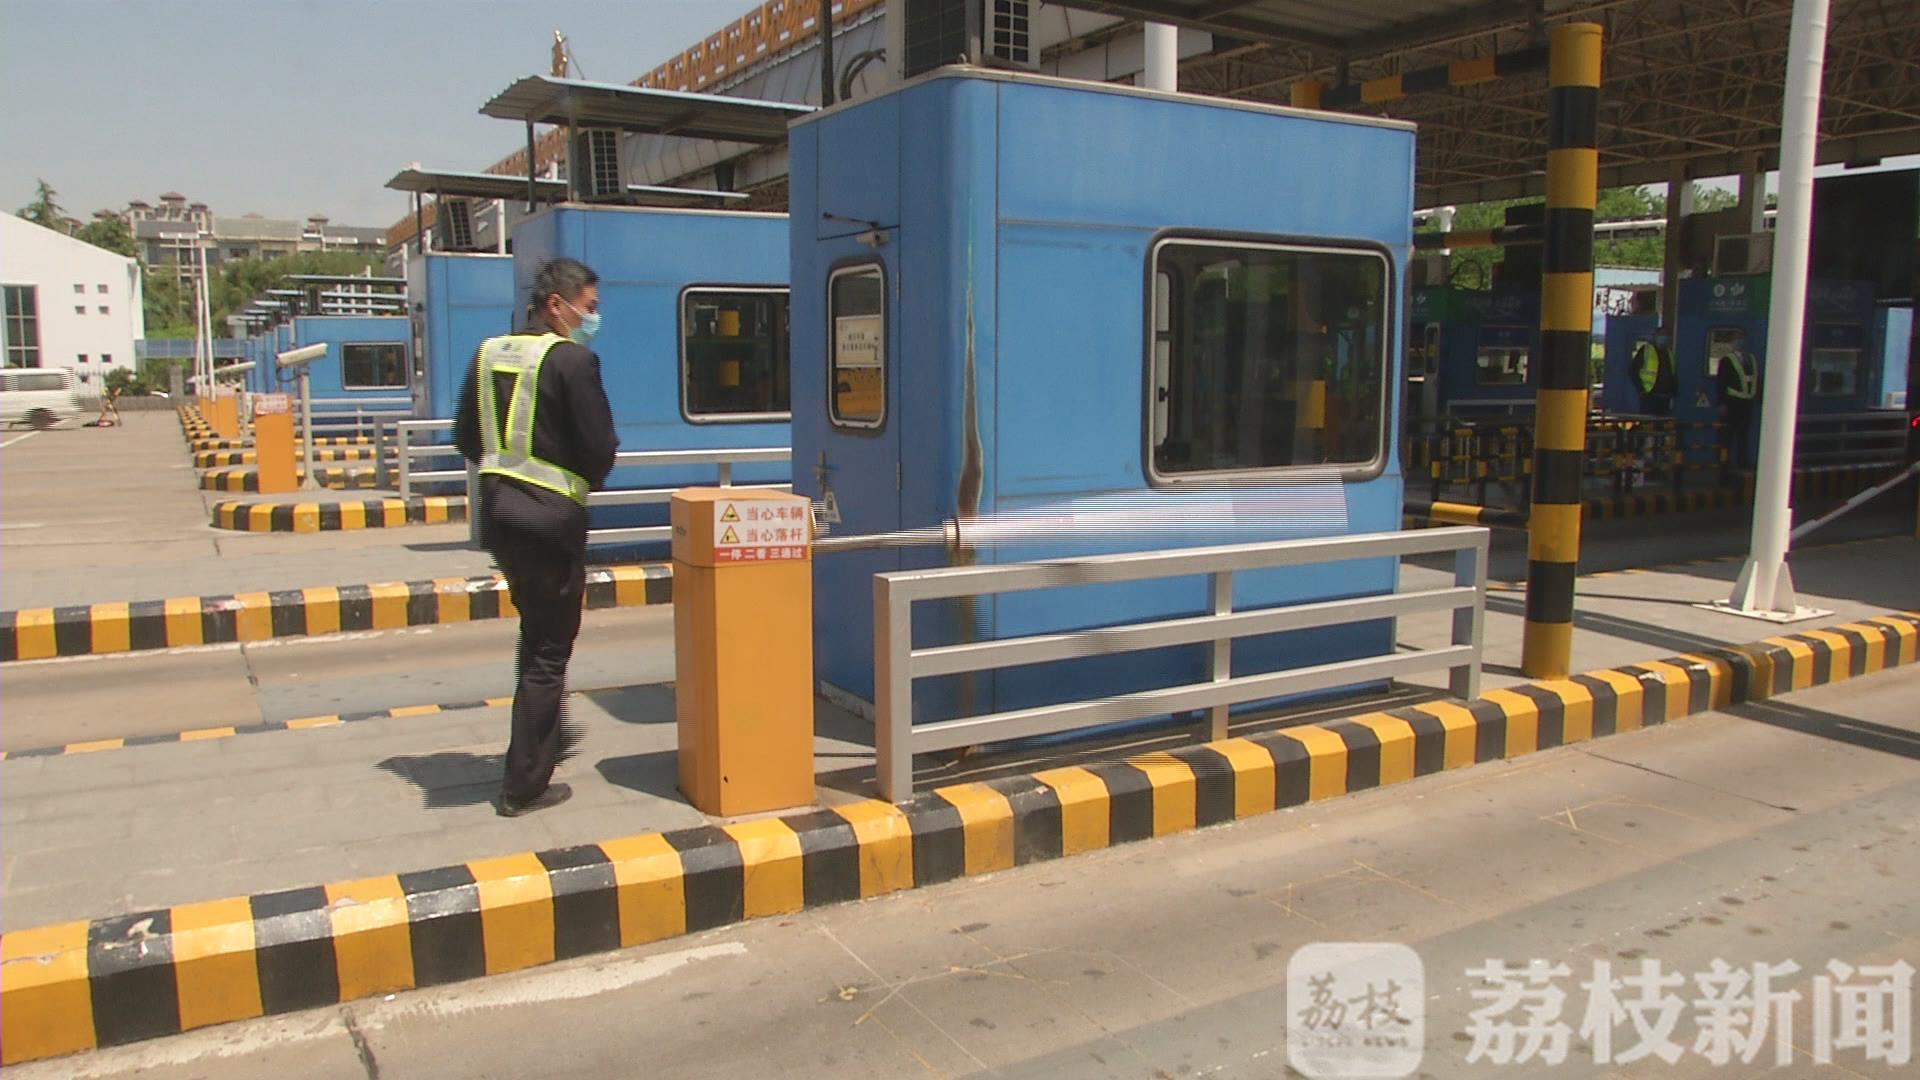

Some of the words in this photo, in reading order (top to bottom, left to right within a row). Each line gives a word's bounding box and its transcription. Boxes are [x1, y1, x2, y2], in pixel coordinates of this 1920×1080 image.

[746, 506, 804, 521] 当心车辆
[746, 527, 802, 542] 当心落杆
